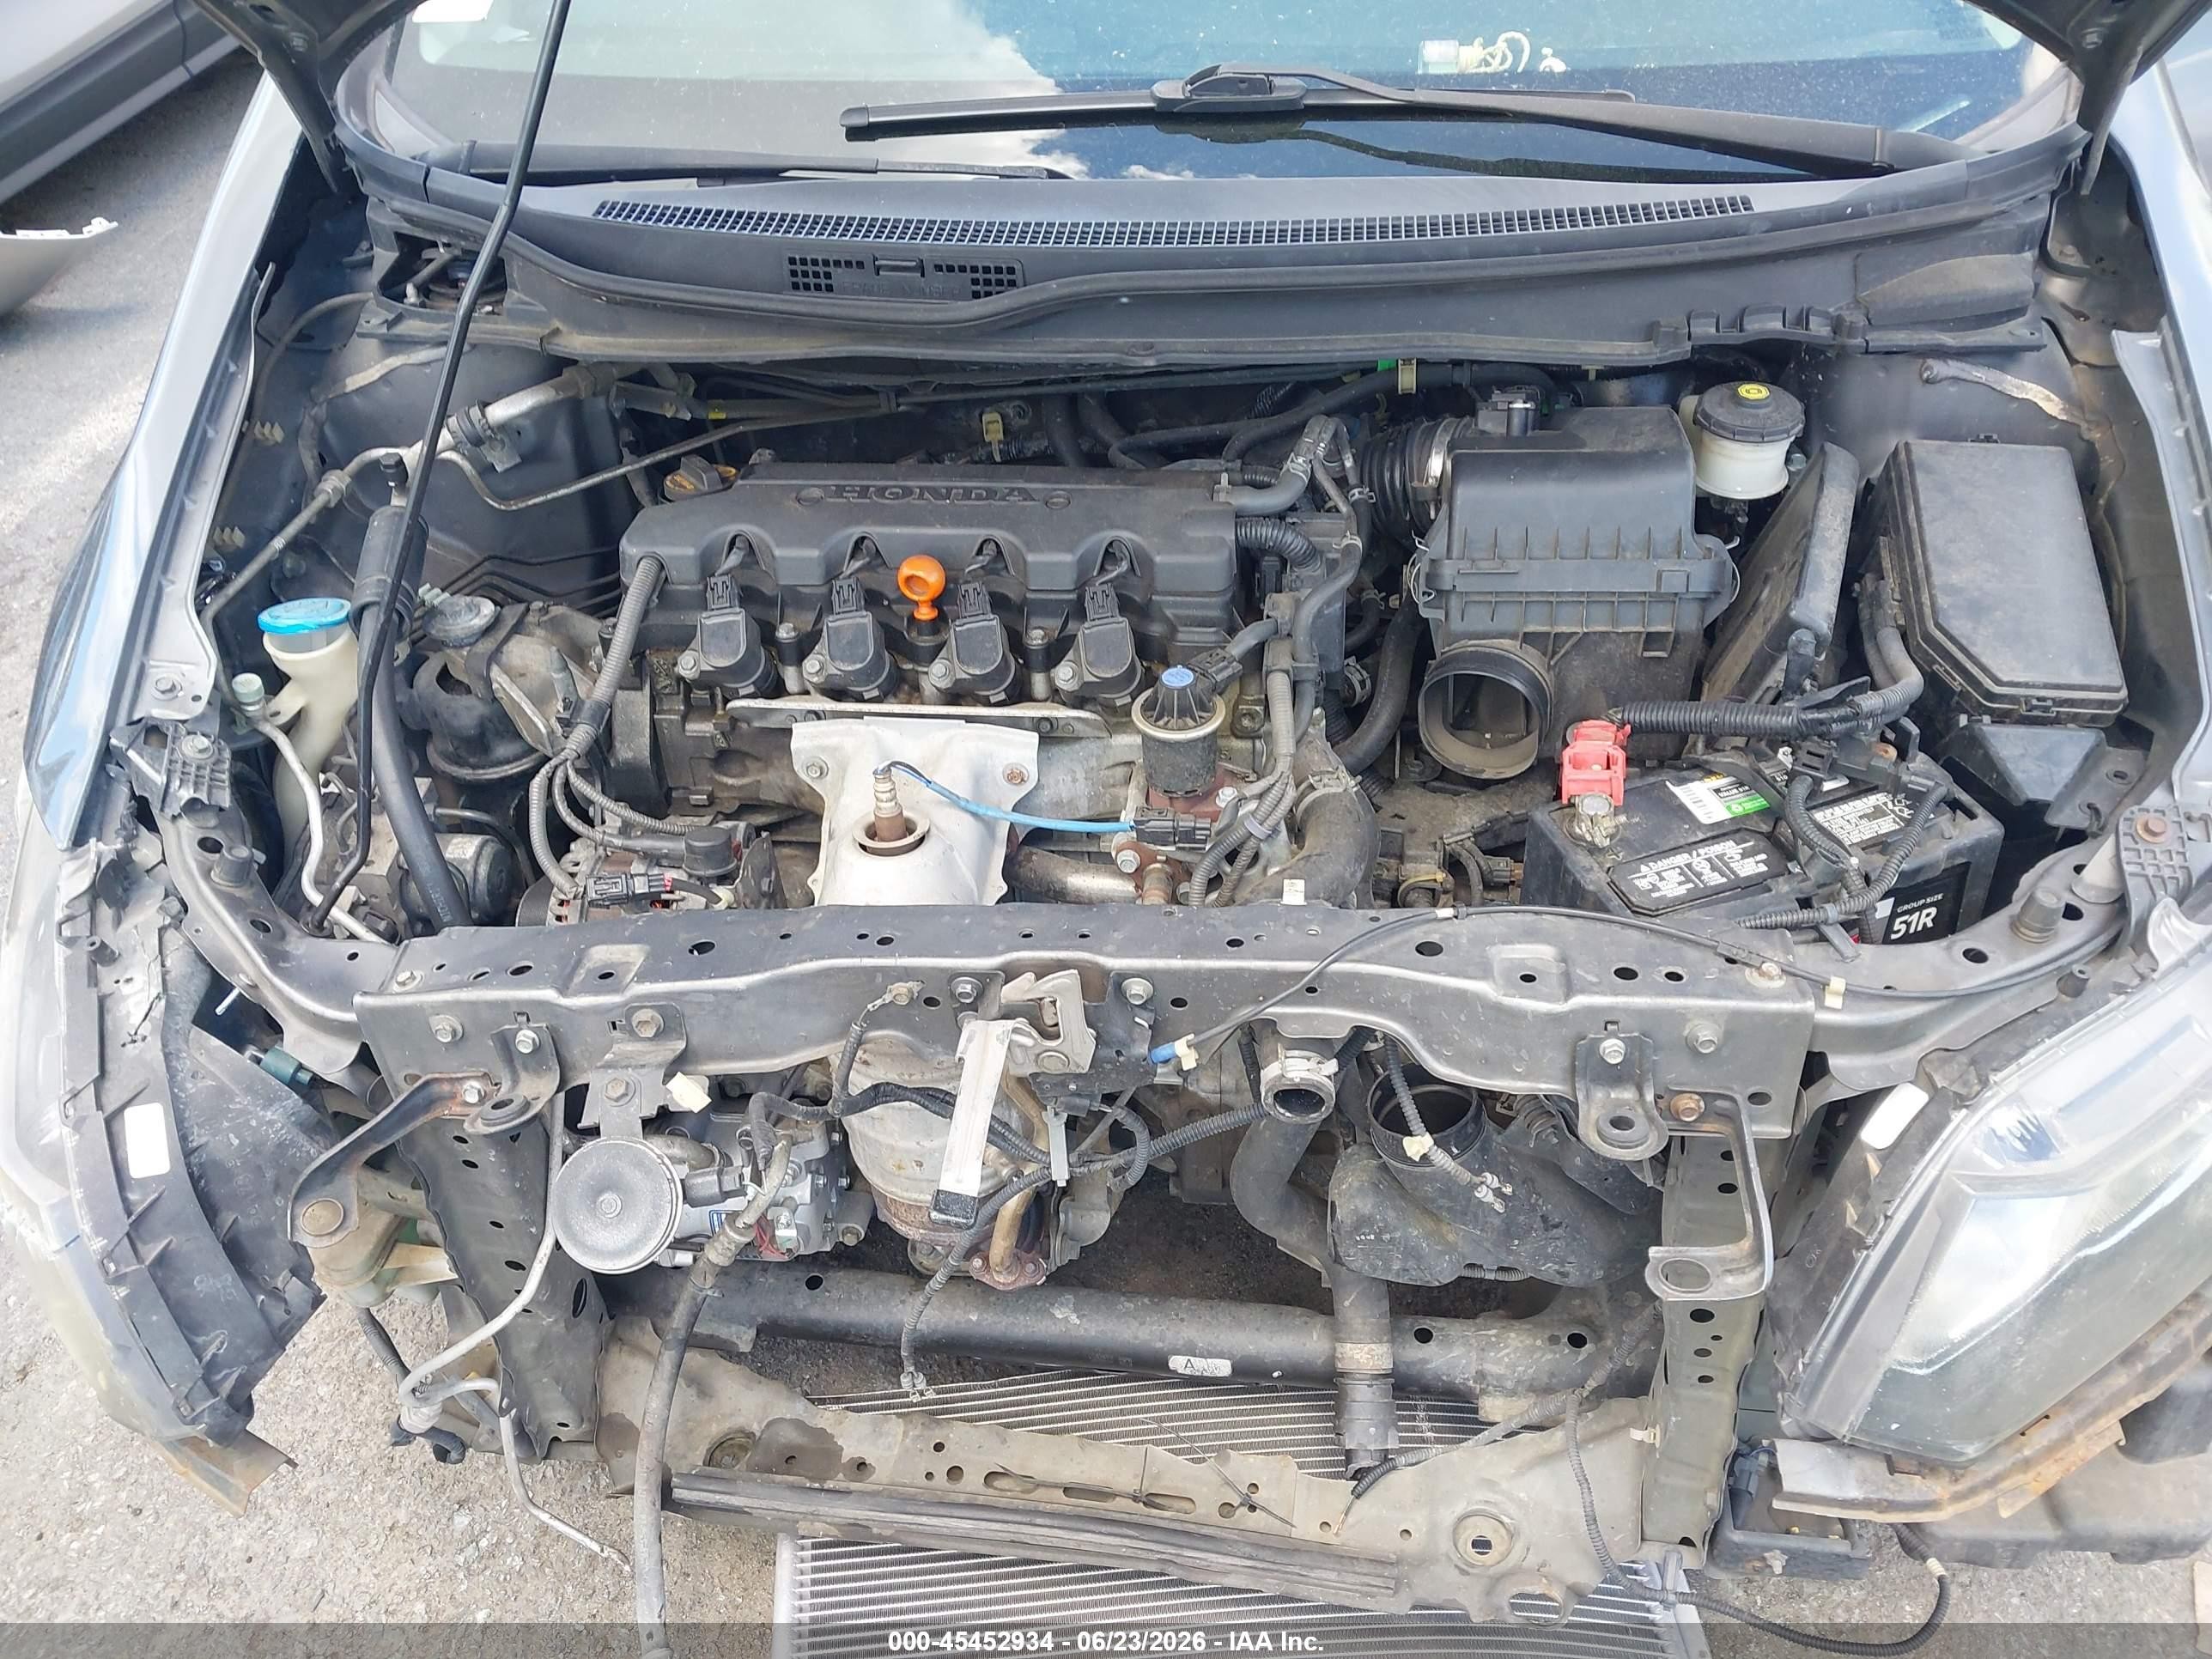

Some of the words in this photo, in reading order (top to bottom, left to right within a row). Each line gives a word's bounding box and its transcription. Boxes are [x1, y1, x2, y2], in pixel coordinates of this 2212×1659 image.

[826, 485, 1041, 505] HONDA
[1649, 852, 1691, 871] DANGER
[1698, 840, 1738, 855] POISON
[1897, 898, 1925, 914] GROUP
[1925, 893, 1944, 904] SIZE
[1891, 907, 1937, 940] 51R
